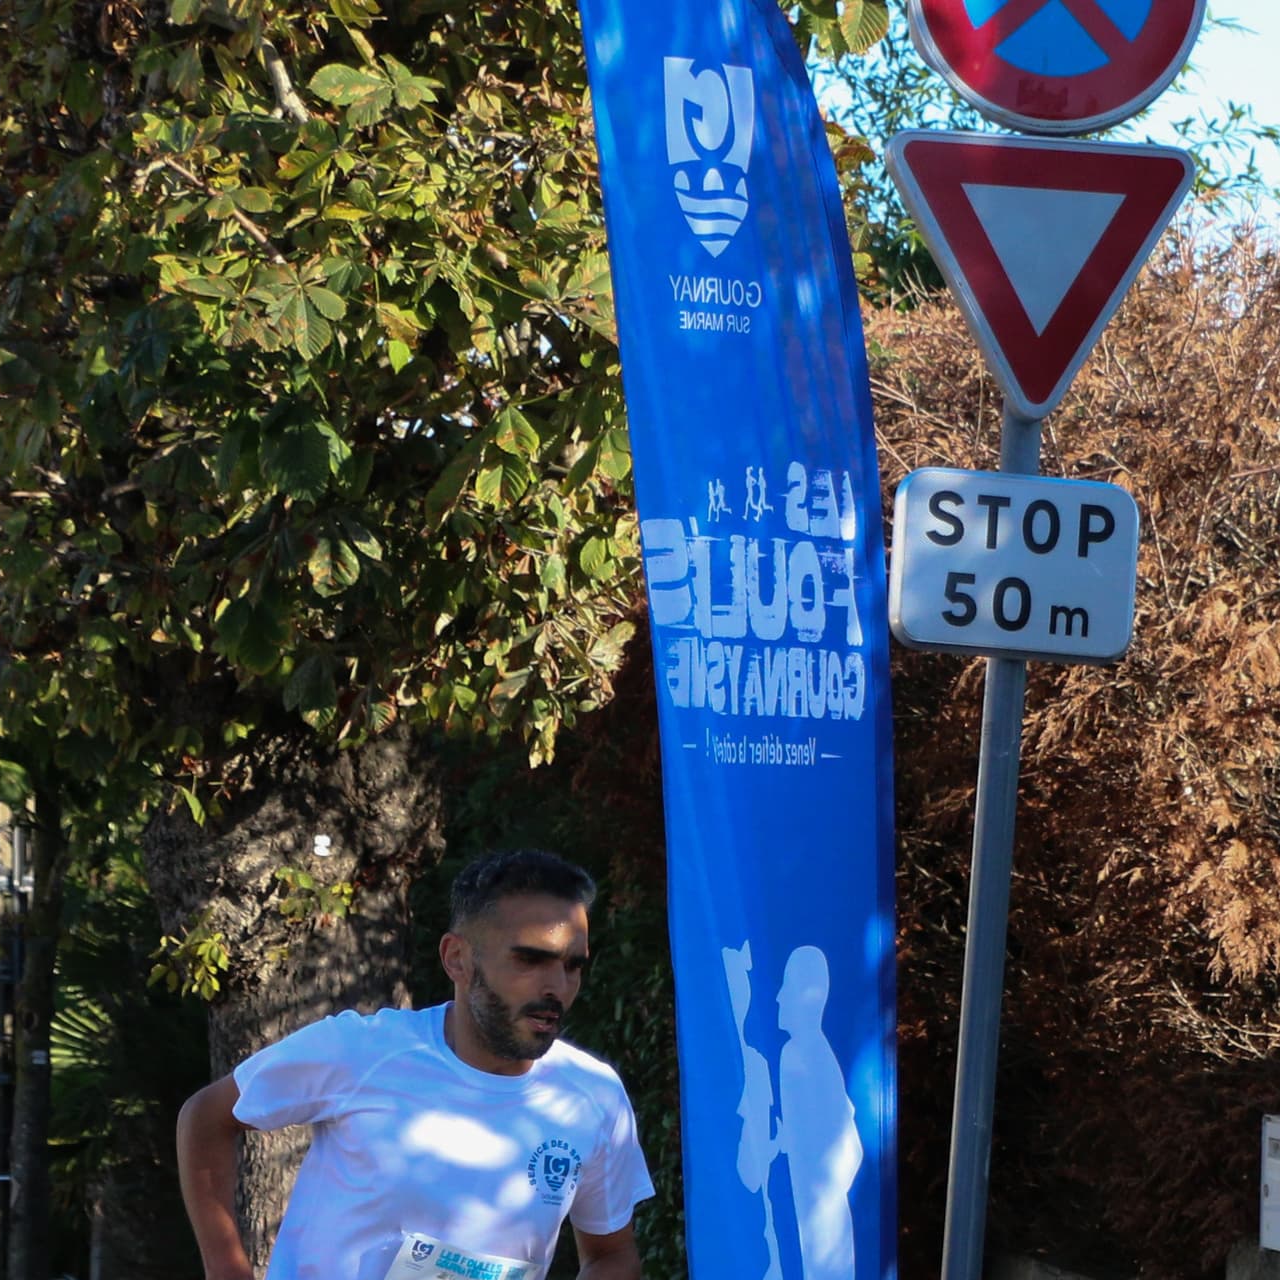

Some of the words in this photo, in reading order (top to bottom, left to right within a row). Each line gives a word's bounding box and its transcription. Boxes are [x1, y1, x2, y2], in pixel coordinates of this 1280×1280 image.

[925, 489, 1116, 558] STOP
[527, 1141, 550, 1186] SERVICE
[551, 1139, 569, 1151] DES
